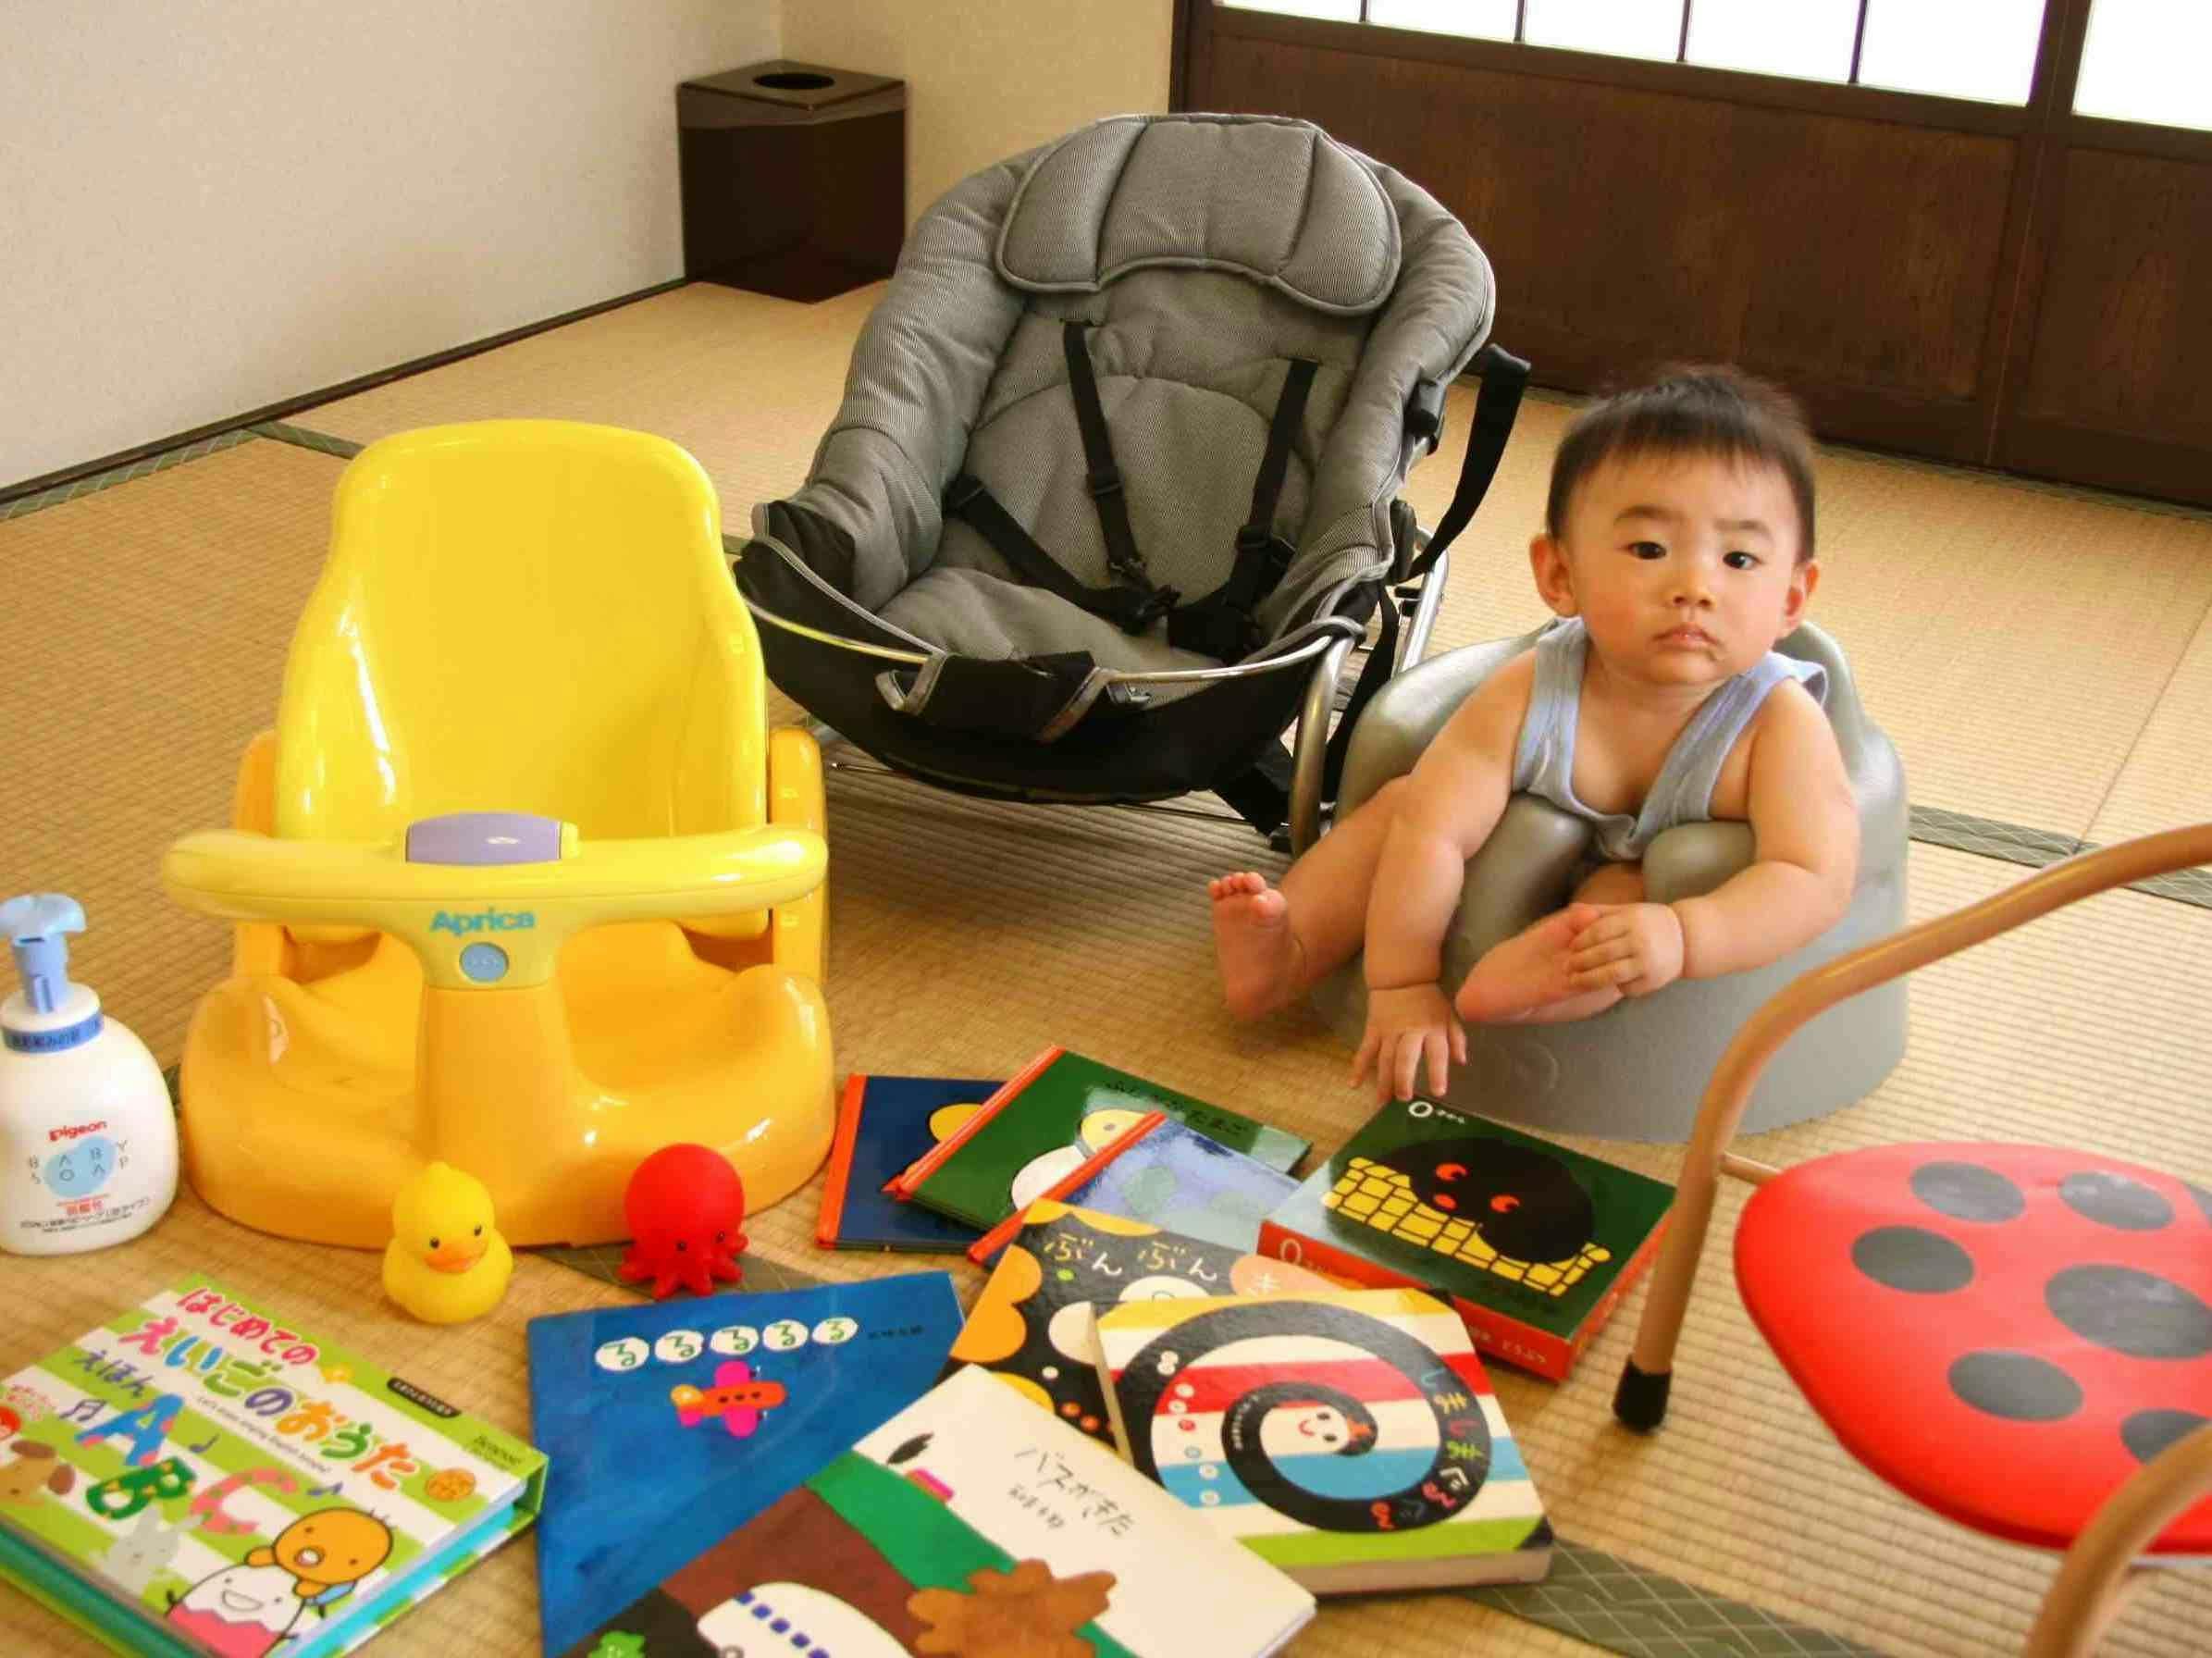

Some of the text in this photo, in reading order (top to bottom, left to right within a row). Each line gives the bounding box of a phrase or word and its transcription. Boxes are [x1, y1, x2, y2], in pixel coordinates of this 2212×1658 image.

[429, 906, 536, 936] Aprica
[49, 1120, 107, 1142] Pigeon
[177, 1288, 317, 1365] はじめての
[74, 1350, 154, 1397] えほん
[119, 1317, 415, 1490] えいごのおうた
[1014, 1447, 1135, 1537] バスがきた
